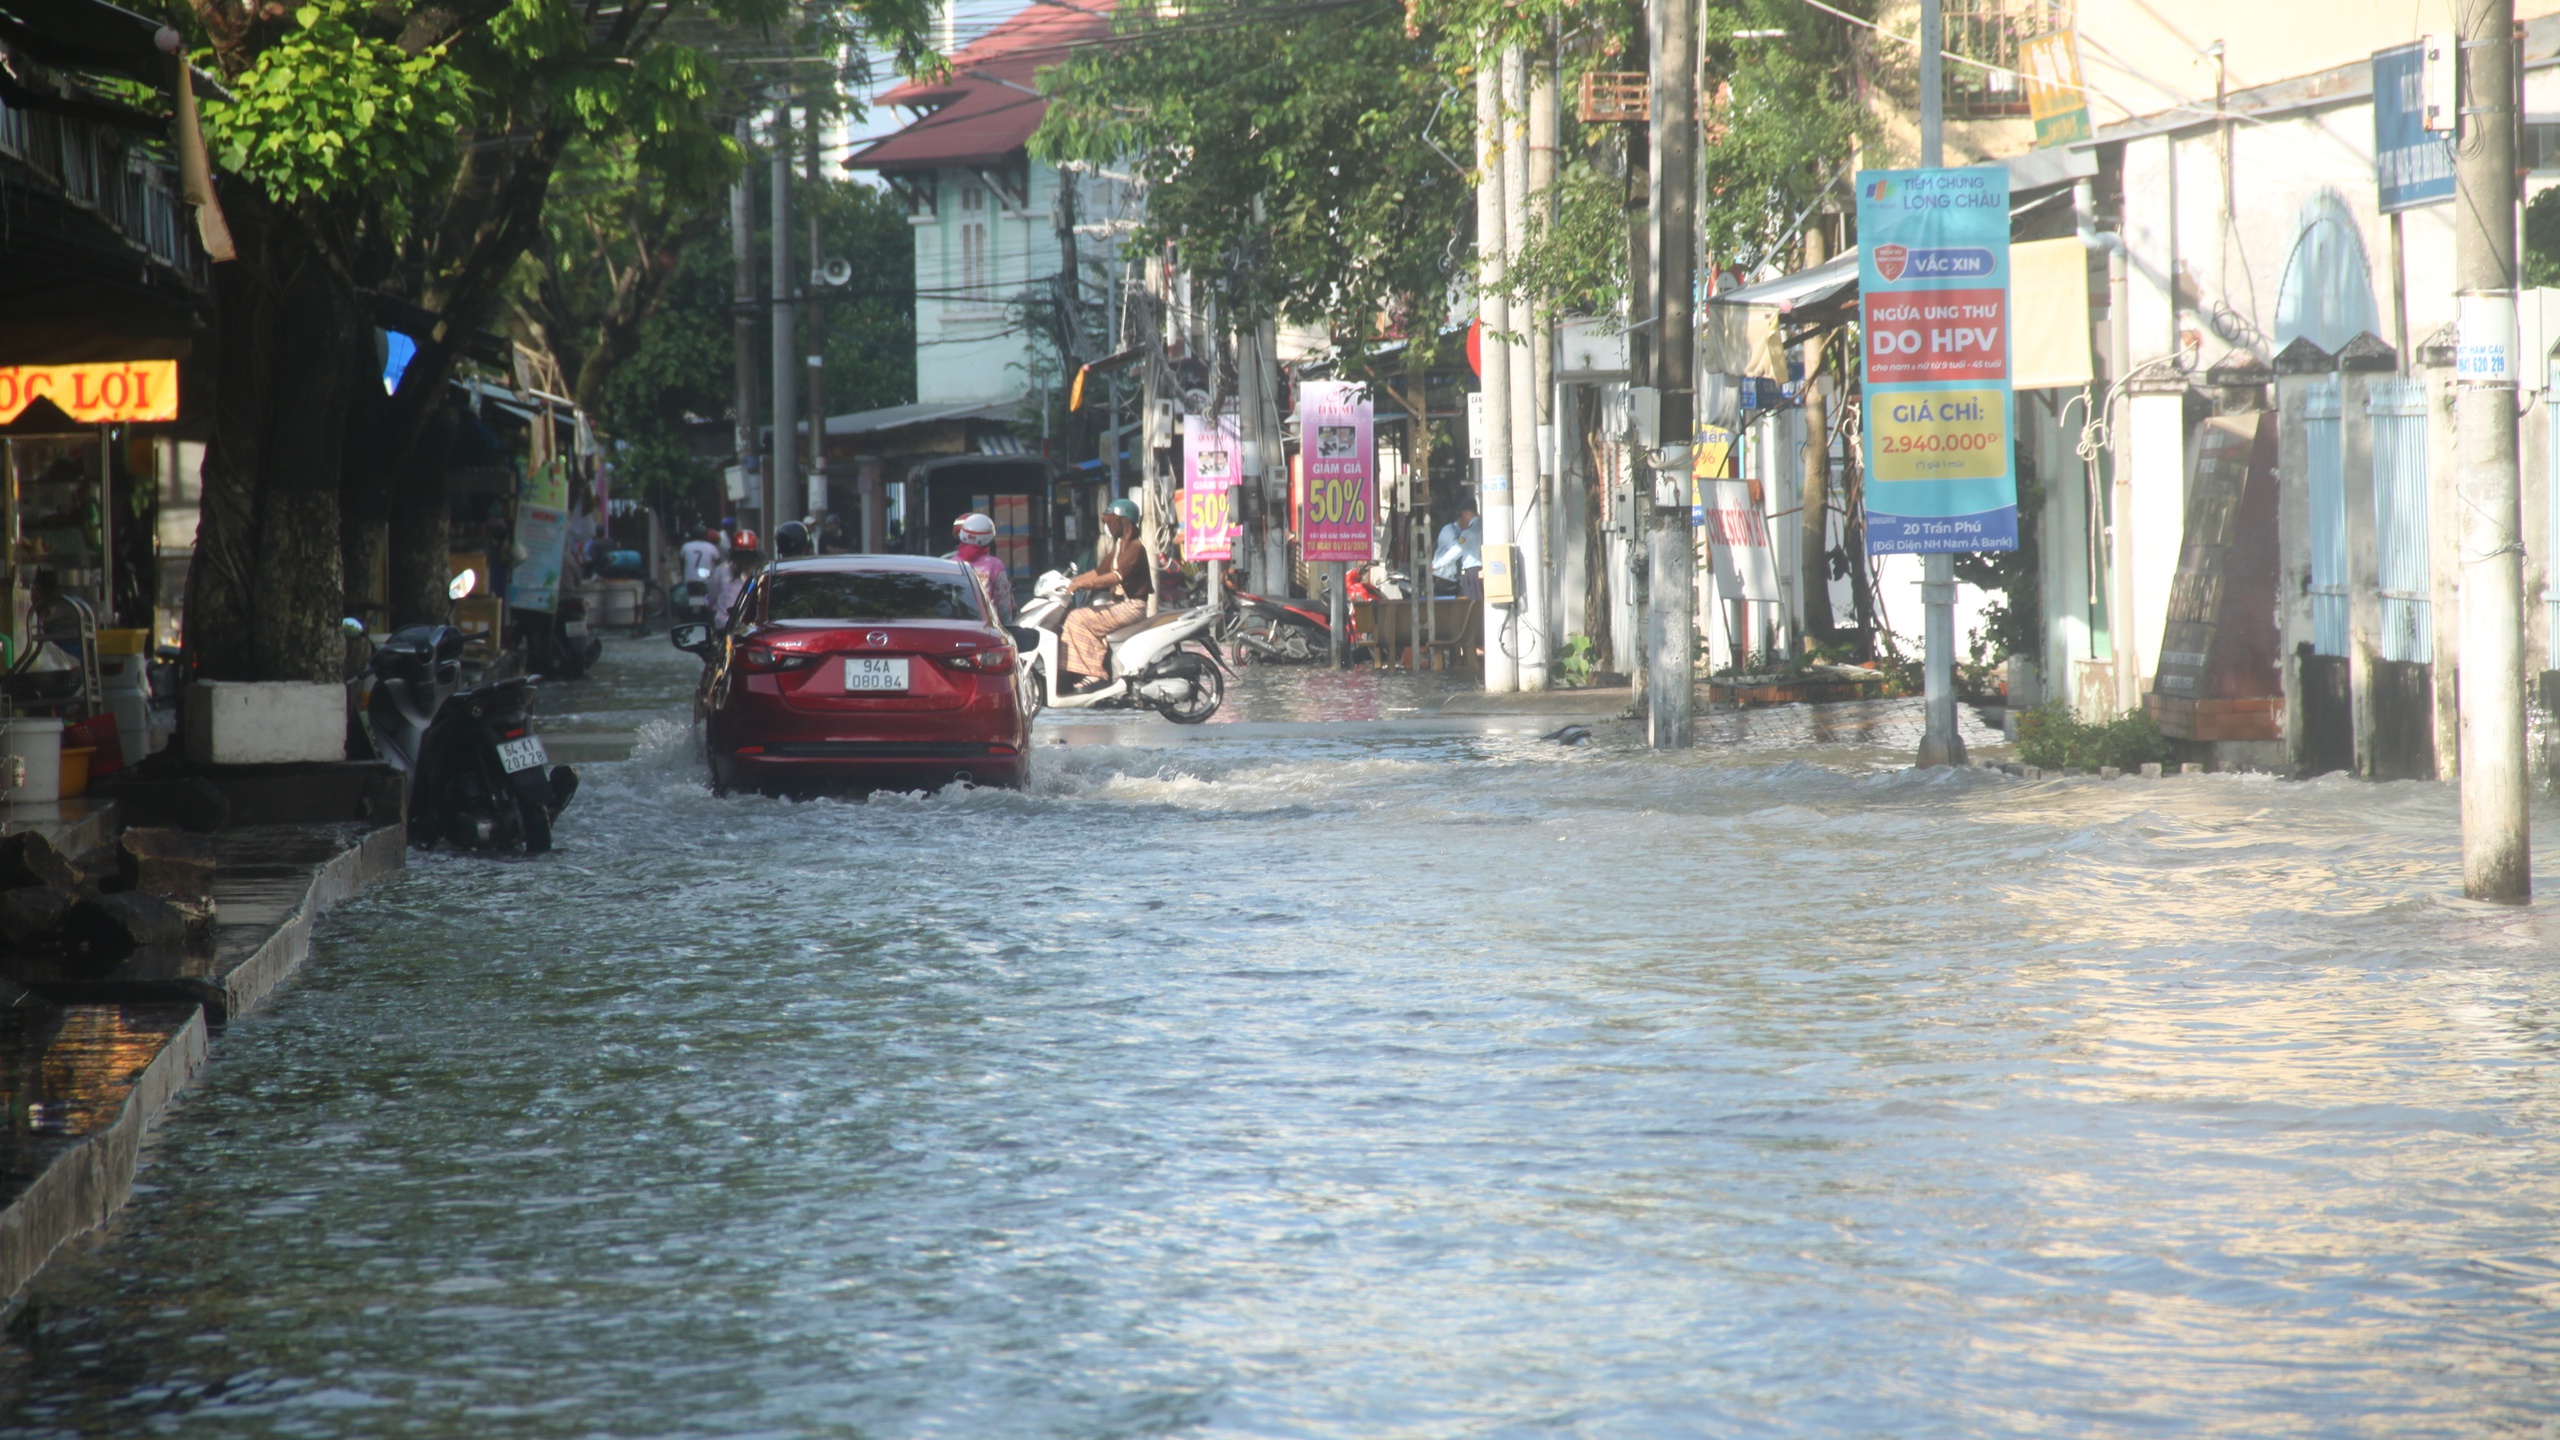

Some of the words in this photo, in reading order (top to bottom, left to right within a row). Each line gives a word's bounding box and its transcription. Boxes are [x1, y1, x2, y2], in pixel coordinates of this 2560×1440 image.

[1903, 194, 1951, 210] LONG
[1955, 190, 2001, 208] CHÂU
[1915, 253, 1949, 272] VẮC
[1952, 258, 1981, 271] XIN
[1873, 304, 1921, 321] NGỪA
[1924, 306, 1960, 320] UNG
[1962, 302, 1998, 318] THƯ
[1873, 329, 1922, 355] DO
[1931, 326, 1999, 353] HPV
[1871, 363, 1889, 372] cho
[1889, 363, 1910, 371] nam
[1942, 361, 1949, 369] 9
[1971, 360, 1983, 368] 45
[72, 364, 151, 418] LỢI
[1893, 400, 1934, 423] GIÁ
[1939, 396, 1984, 421] CHỈ:
[1312, 460, 1340, 474] GIẢM
[1343, 460, 1362, 474] GIÁ
[1309, 477, 1366, 525] 50%
[1903, 523, 1920, 535] 20
[1922, 520, 1952, 534] Trần
[1954, 520, 1982, 533] Phú
[1897, 540, 1922, 551] Diện
[1924, 540, 1941, 549] NH
[1943, 540, 1969, 548] Nam
[1970, 535, 1980, 548] Á
[1982, 536, 2013, 549] Bank)
[863, 659, 890, 674] 94A
[852, 674, 902, 688] 080.84
